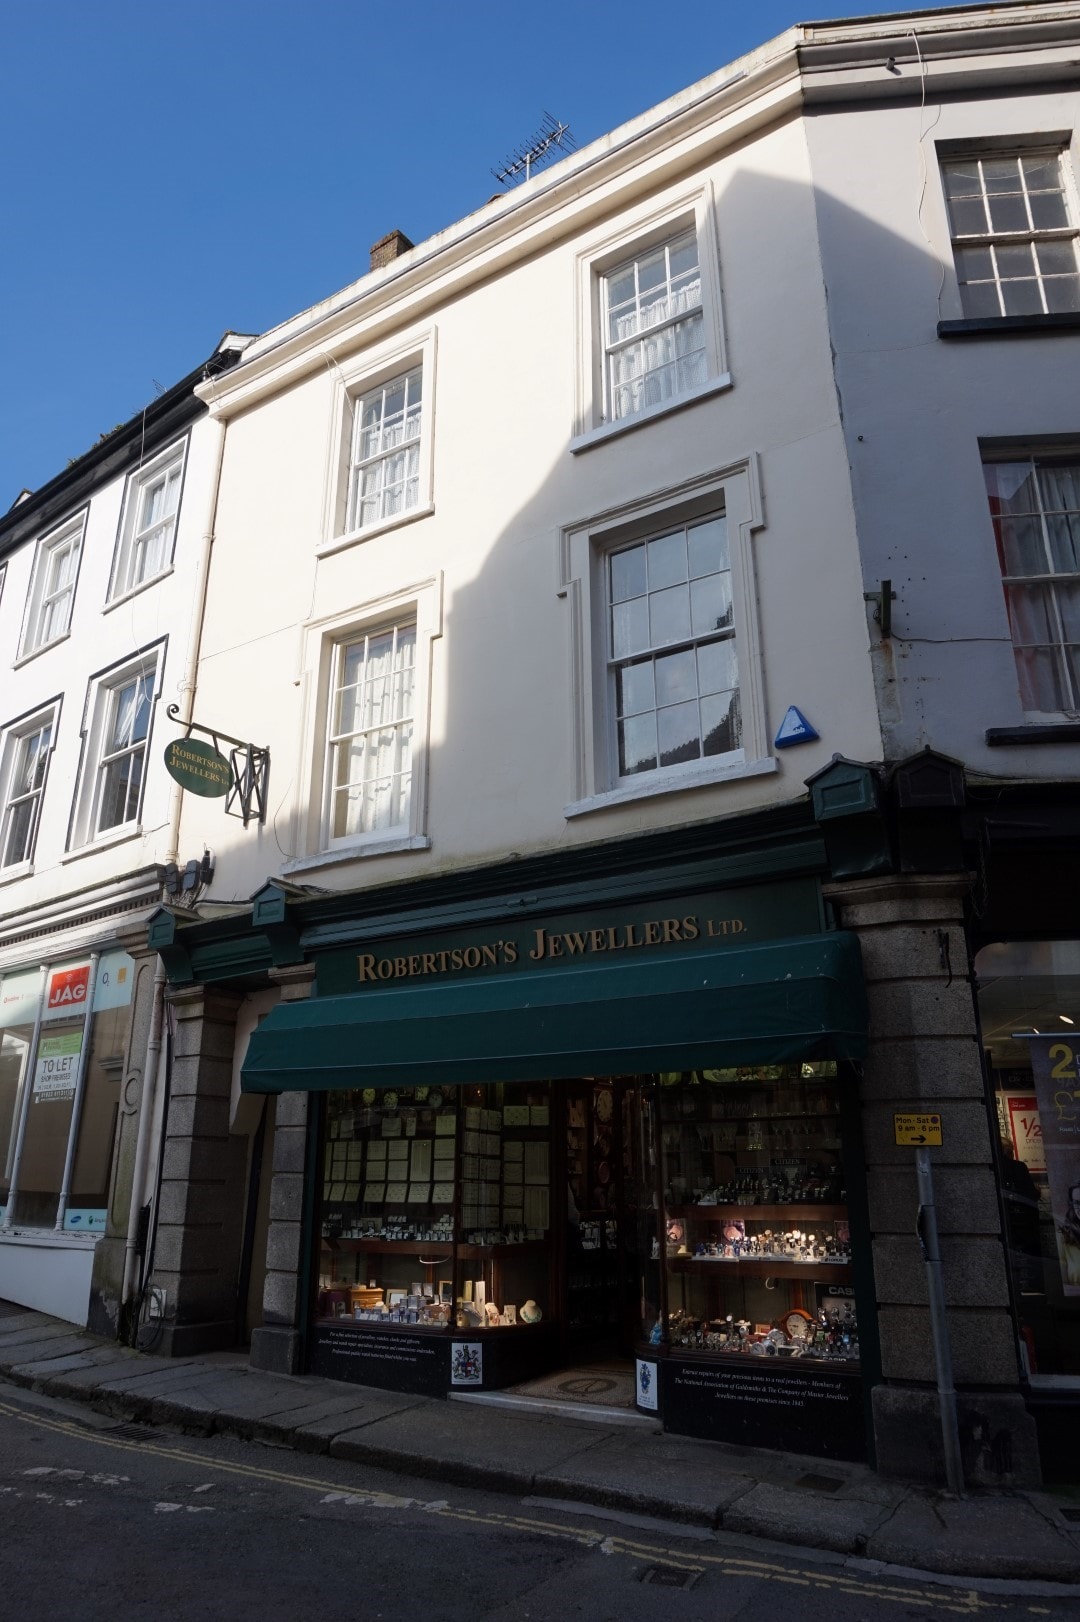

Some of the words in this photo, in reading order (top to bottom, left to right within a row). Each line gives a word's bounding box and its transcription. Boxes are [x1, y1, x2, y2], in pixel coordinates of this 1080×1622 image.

[169, 756, 220, 782] JEWELLERS
[356, 940, 517, 982] ROBERTSON'S
[529, 915, 699, 960] JEWELLERS
[50, 983, 86, 1004] JAG
[43, 1059, 54, 1074] TO
[56, 1056, 74, 1072] LET
[828, 1286, 857, 1296] CASI
